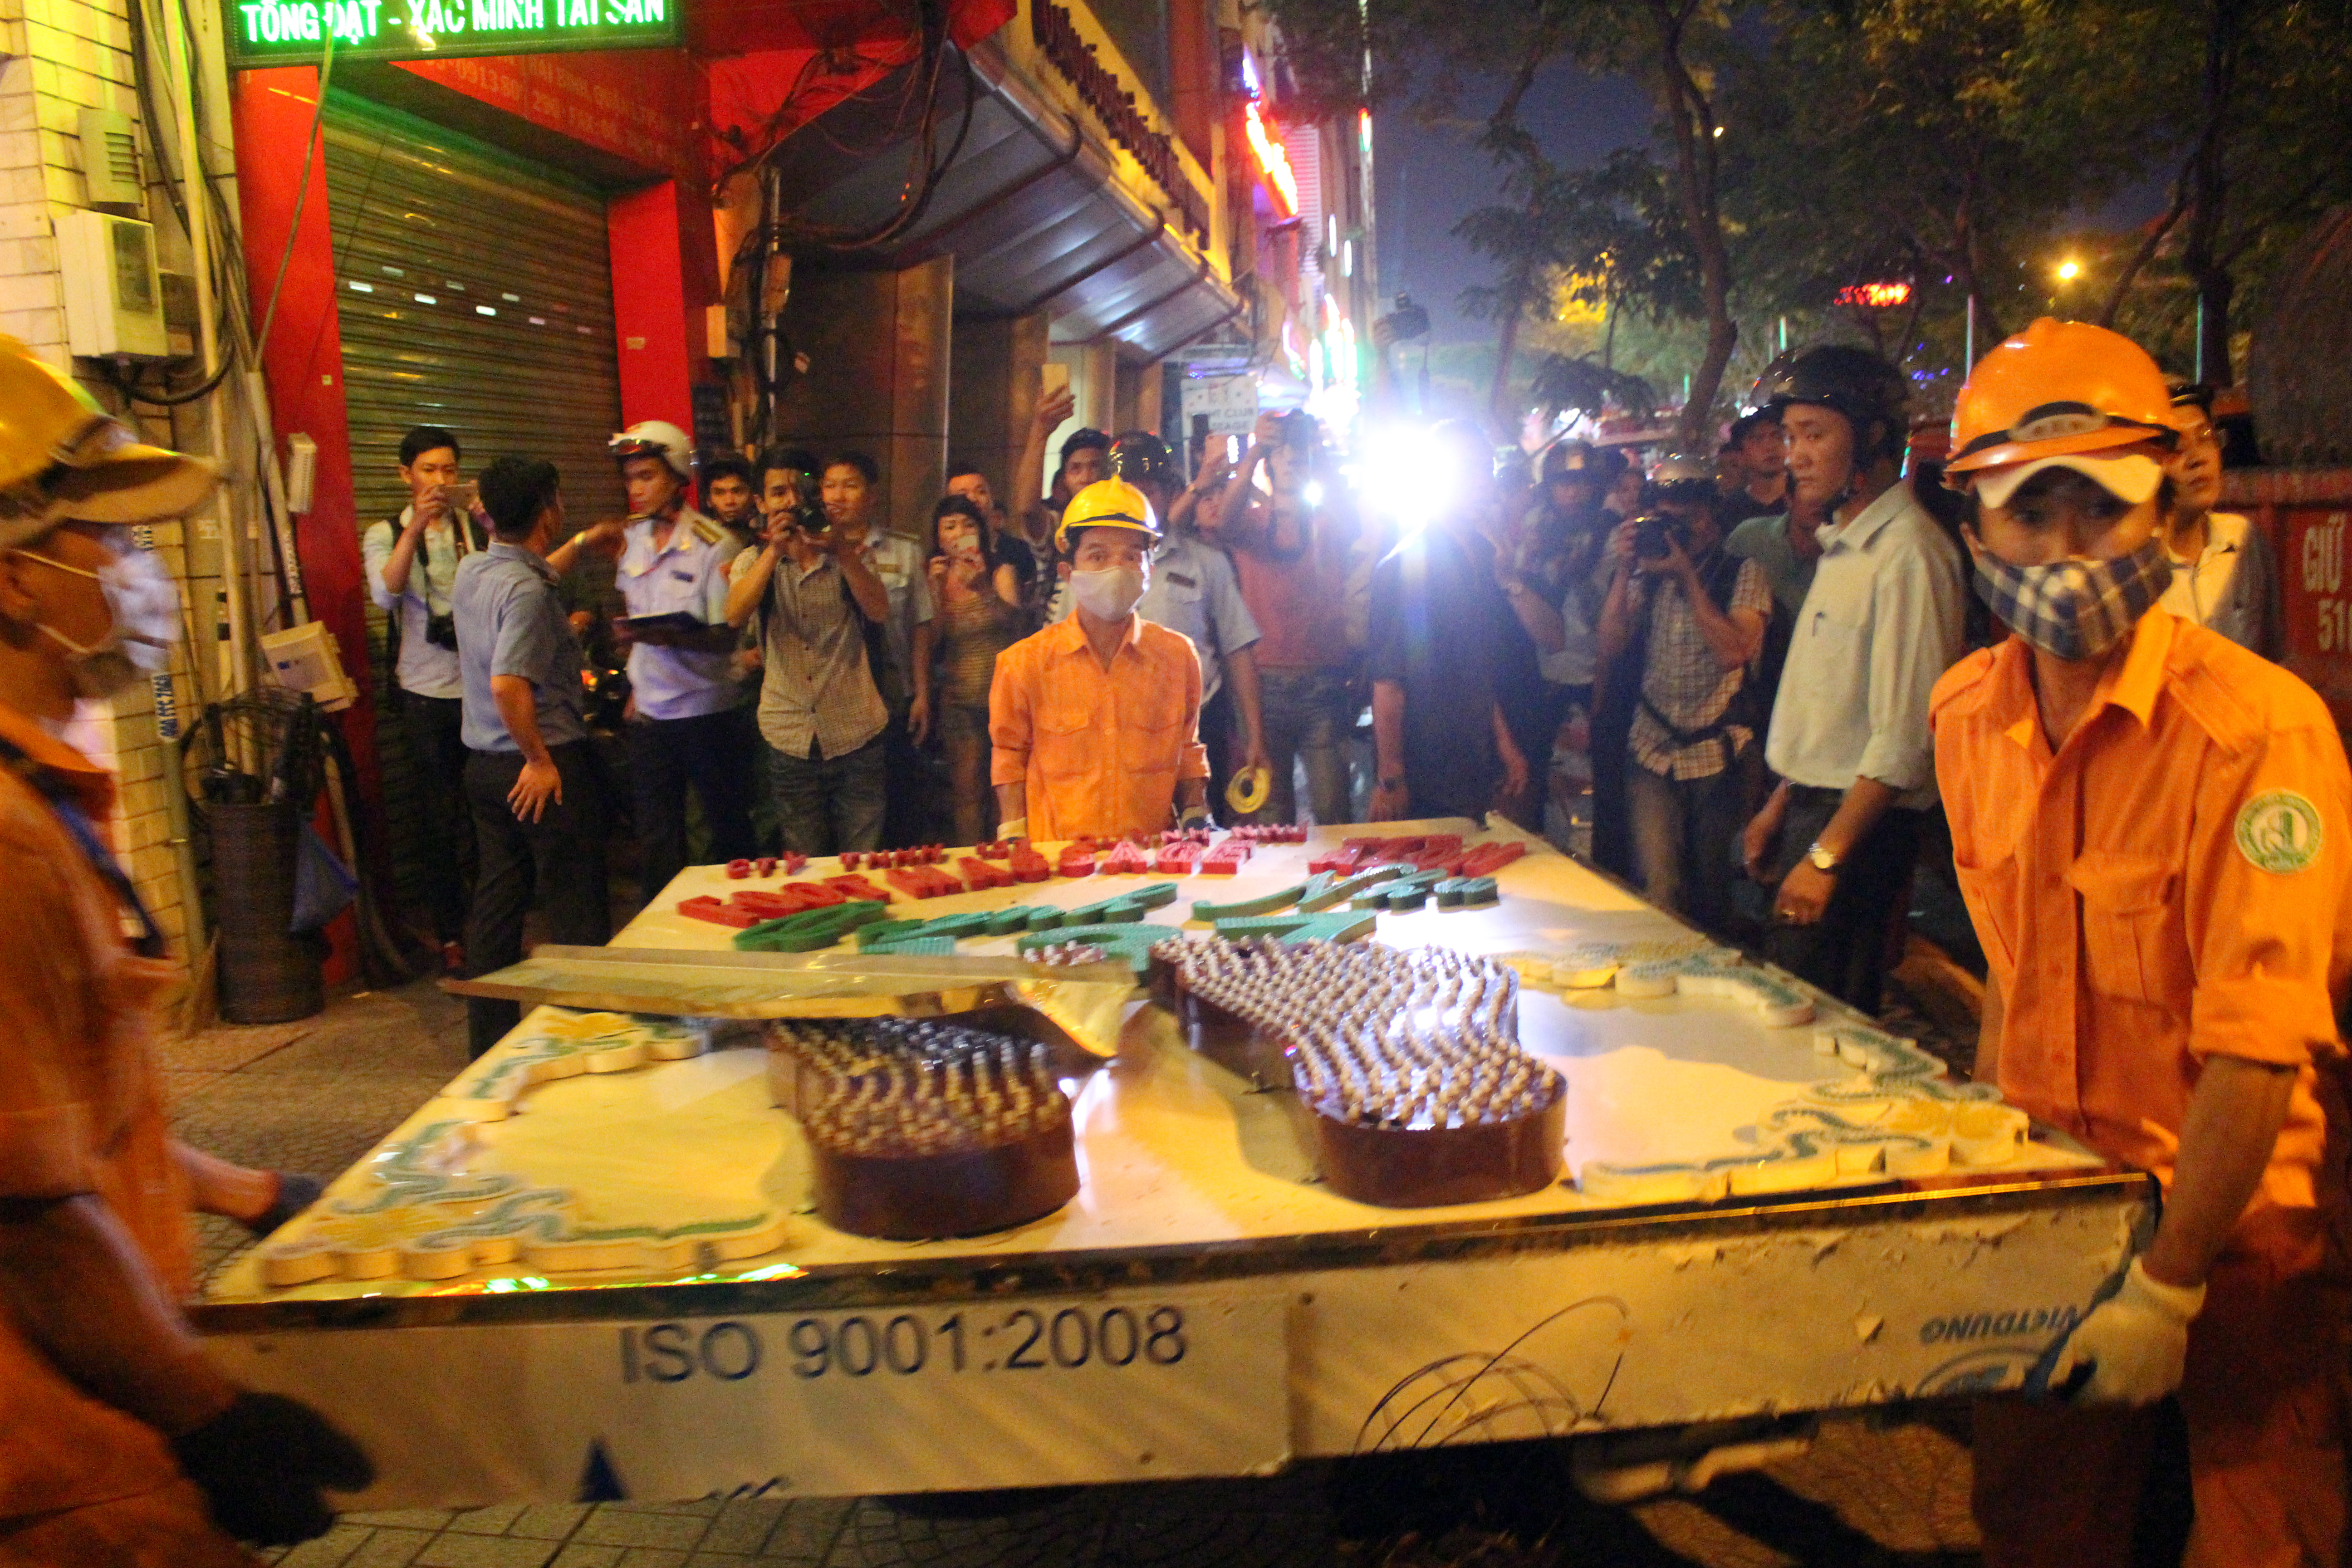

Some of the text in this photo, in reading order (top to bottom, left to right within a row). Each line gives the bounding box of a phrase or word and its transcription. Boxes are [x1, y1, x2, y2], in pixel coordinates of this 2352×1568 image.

[473, 0, 544, 31] MINH
[2318, 598, 2352, 652] 51
[620, 1303, 1187, 1384] ISO 9001:2008
